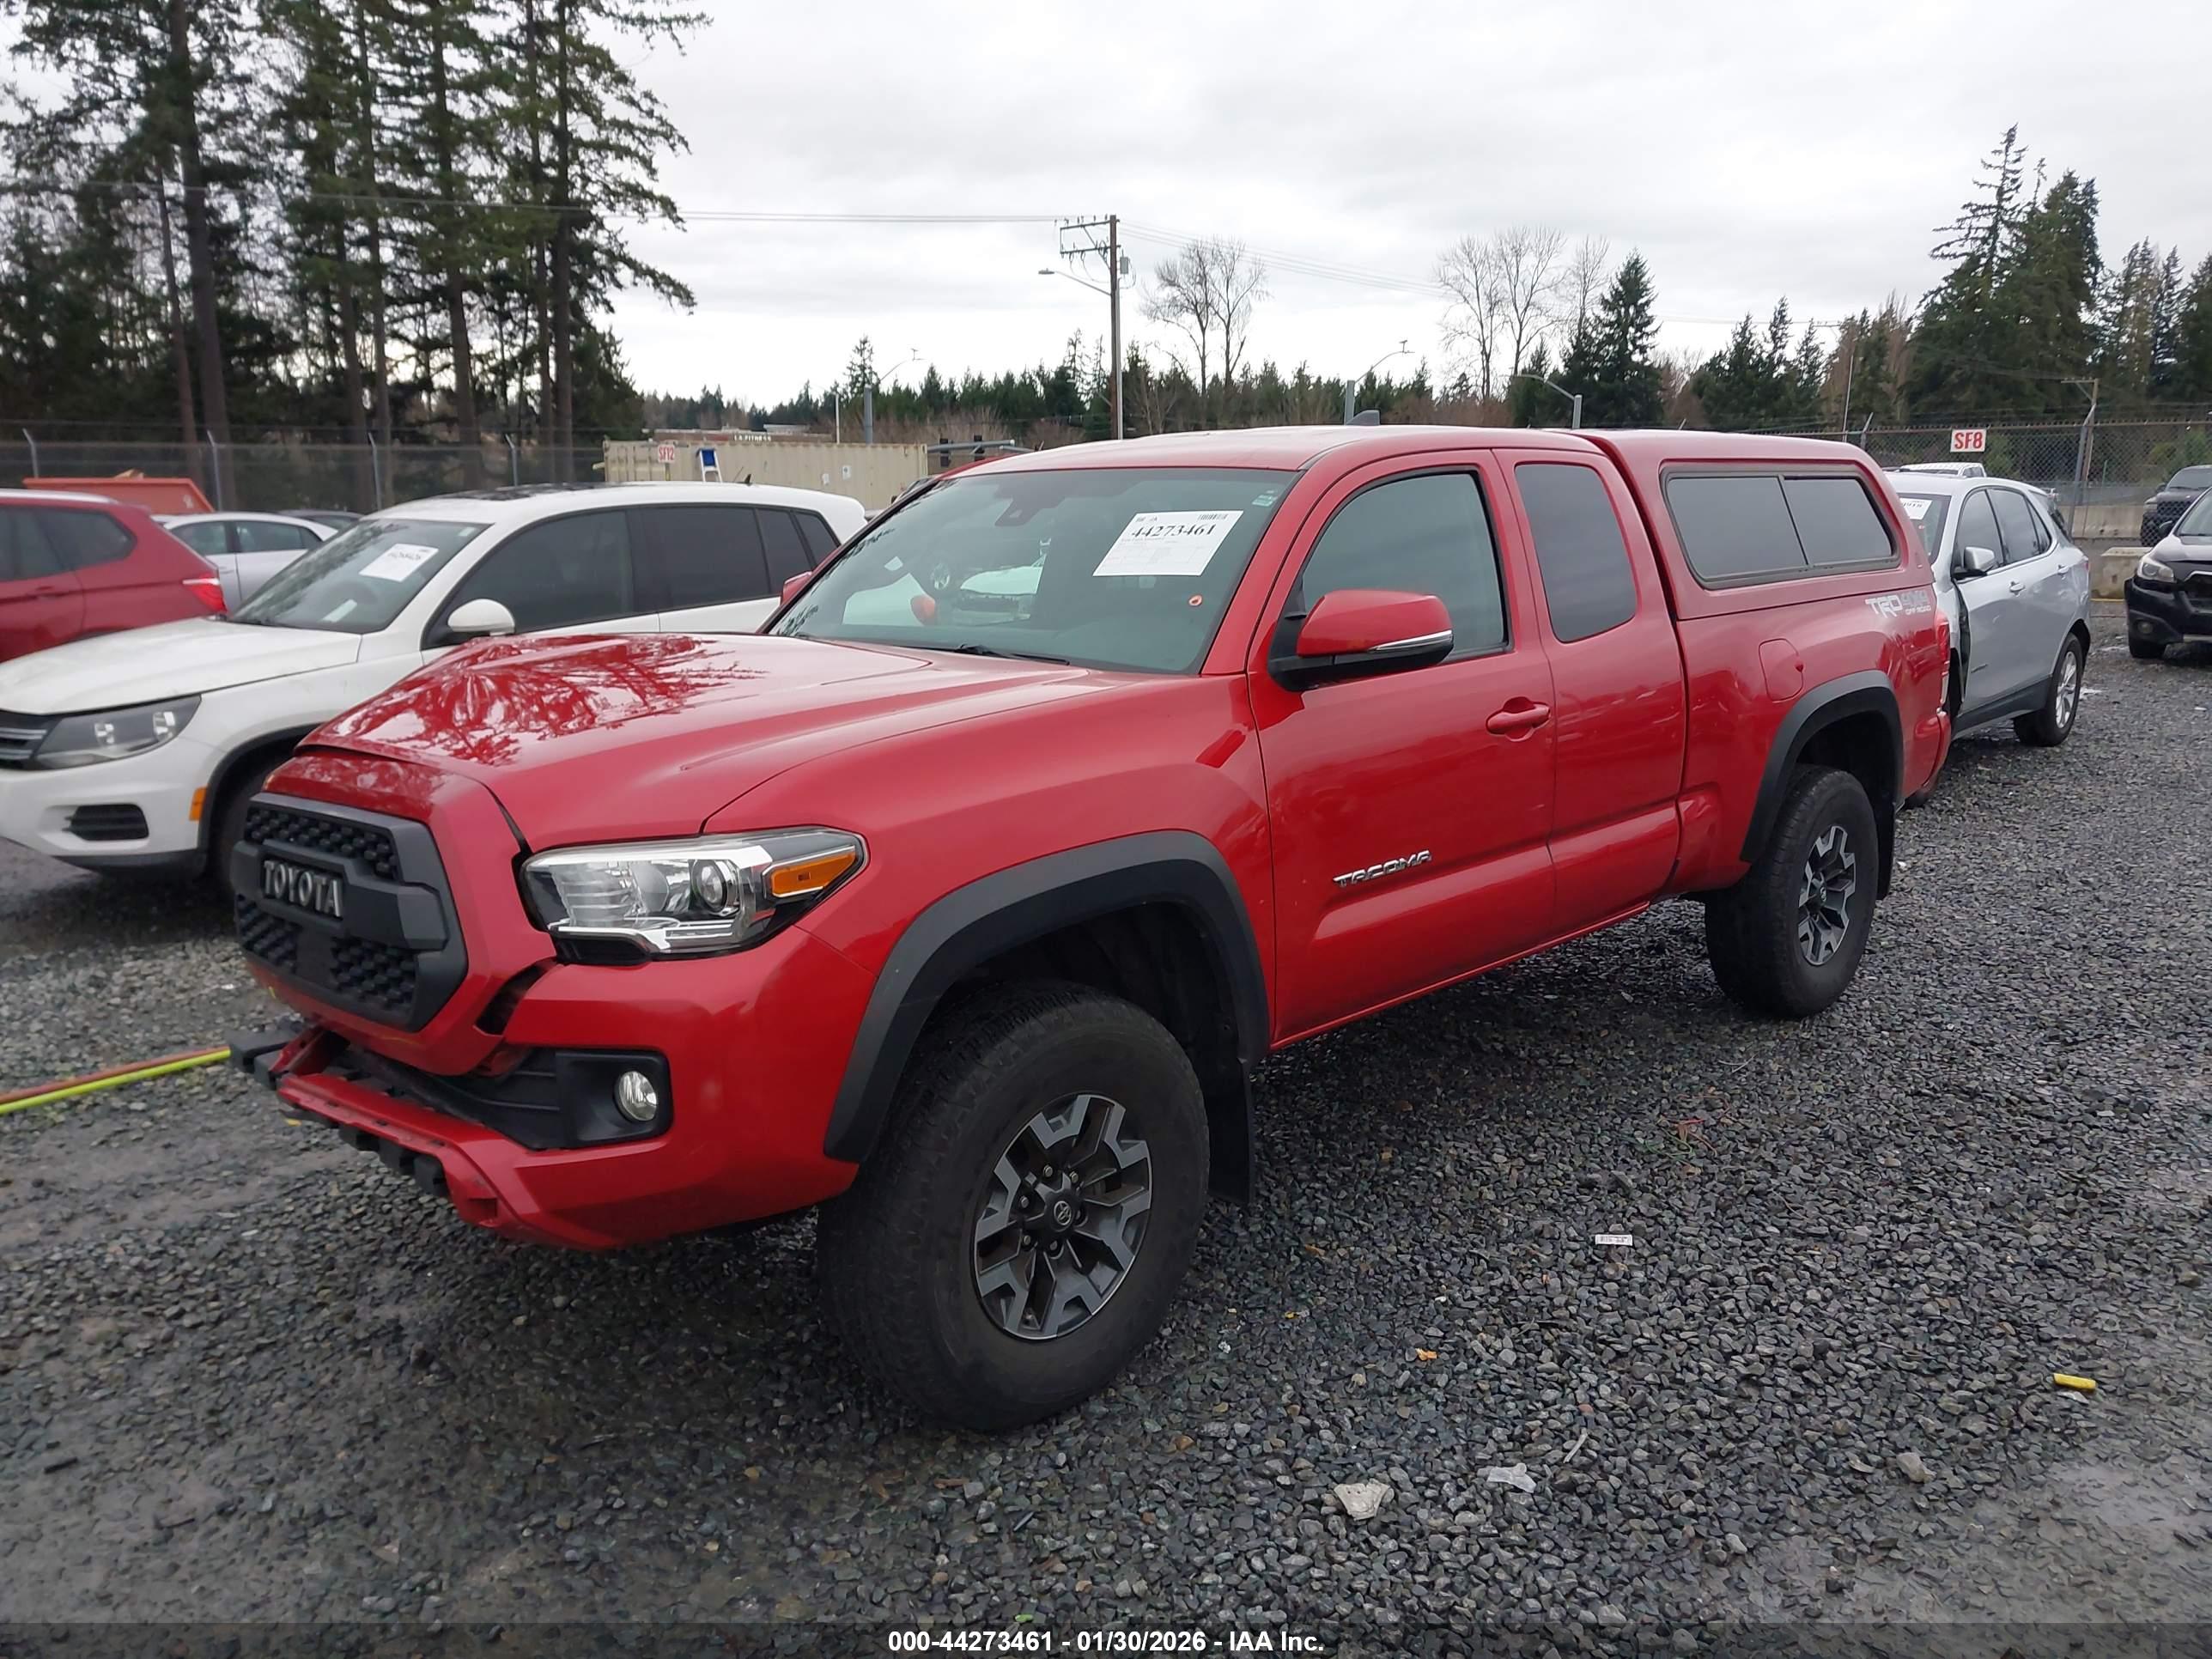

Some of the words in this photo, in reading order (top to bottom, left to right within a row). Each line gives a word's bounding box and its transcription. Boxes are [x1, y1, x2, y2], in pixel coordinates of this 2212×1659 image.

[1954, 432, 1983, 449] SF8
[659, 444, 674, 460] SF12
[1132, 523, 1217, 538] 44273461
[1864, 594, 1903, 618] TRD
[1333, 849, 1432, 887] TACOMA
[263, 860, 343, 917] TOYOTA
